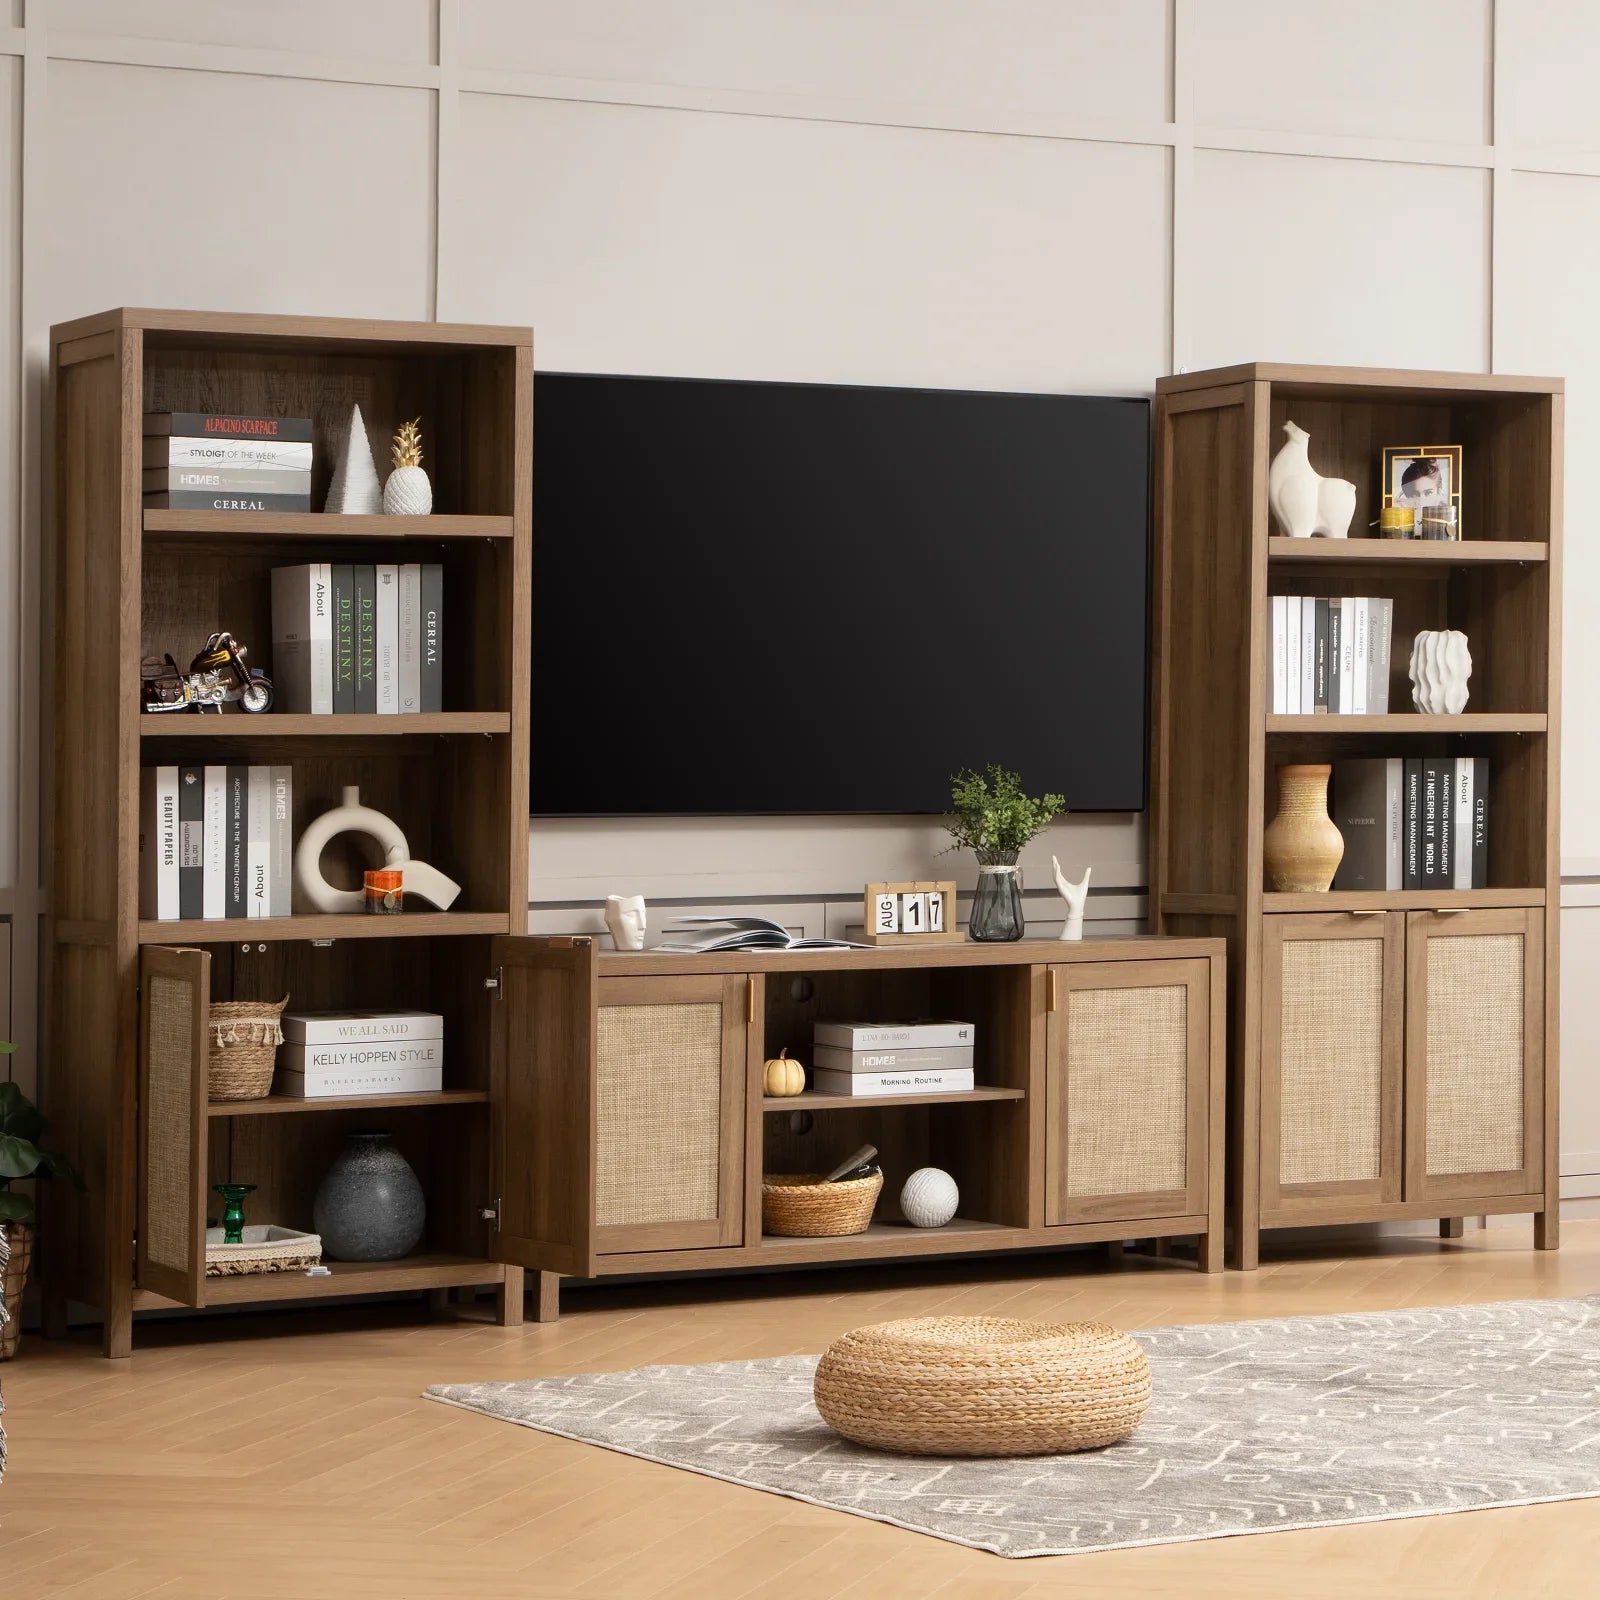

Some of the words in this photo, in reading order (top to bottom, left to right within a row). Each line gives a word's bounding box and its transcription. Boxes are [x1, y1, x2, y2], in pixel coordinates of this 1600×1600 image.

[241, 419, 279, 435] SCARFACE
[228, 450, 238, 458] OF
[241, 450, 254, 459] THE
[256, 452, 277, 460] WEEK
[180, 474, 220, 486] HOMES
[213, 500, 265, 510] CEREAL
[316, 582, 325, 617] About
[341, 599, 351, 681] DESTINY
[362, 598, 372, 681] DESTINY
[427, 611, 436, 665] CEREAL
[276, 778, 286, 820] HOMES
[1426, 770, 1435, 838] FINGERPRINT
[1442, 774, 1450, 819] MARKETING
[1461, 774, 1469, 804] About
[164, 796, 173, 829] BEAUTY
[1476, 798, 1484, 846] CEREAL
[164, 832, 173, 866] PAPERS
[1409, 820, 1417, 876] MANAGEMENT
[1425, 843, 1434, 874] WORLD
[1441, 820, 1449, 876] MANAGEMENT
[255, 864, 264, 898] About
[880, 901, 893, 928] AUG
[338, 1026, 358, 1036] WE
[358, 1025, 381, 1036] ALL
[383, 1024, 409, 1034] SAID
[313, 1052, 348, 1066] KELLY
[350, 1050, 397, 1064] HOPPEN
[399, 1048, 434, 1061] STYLE
[862, 1055, 896, 1067] HOMES
